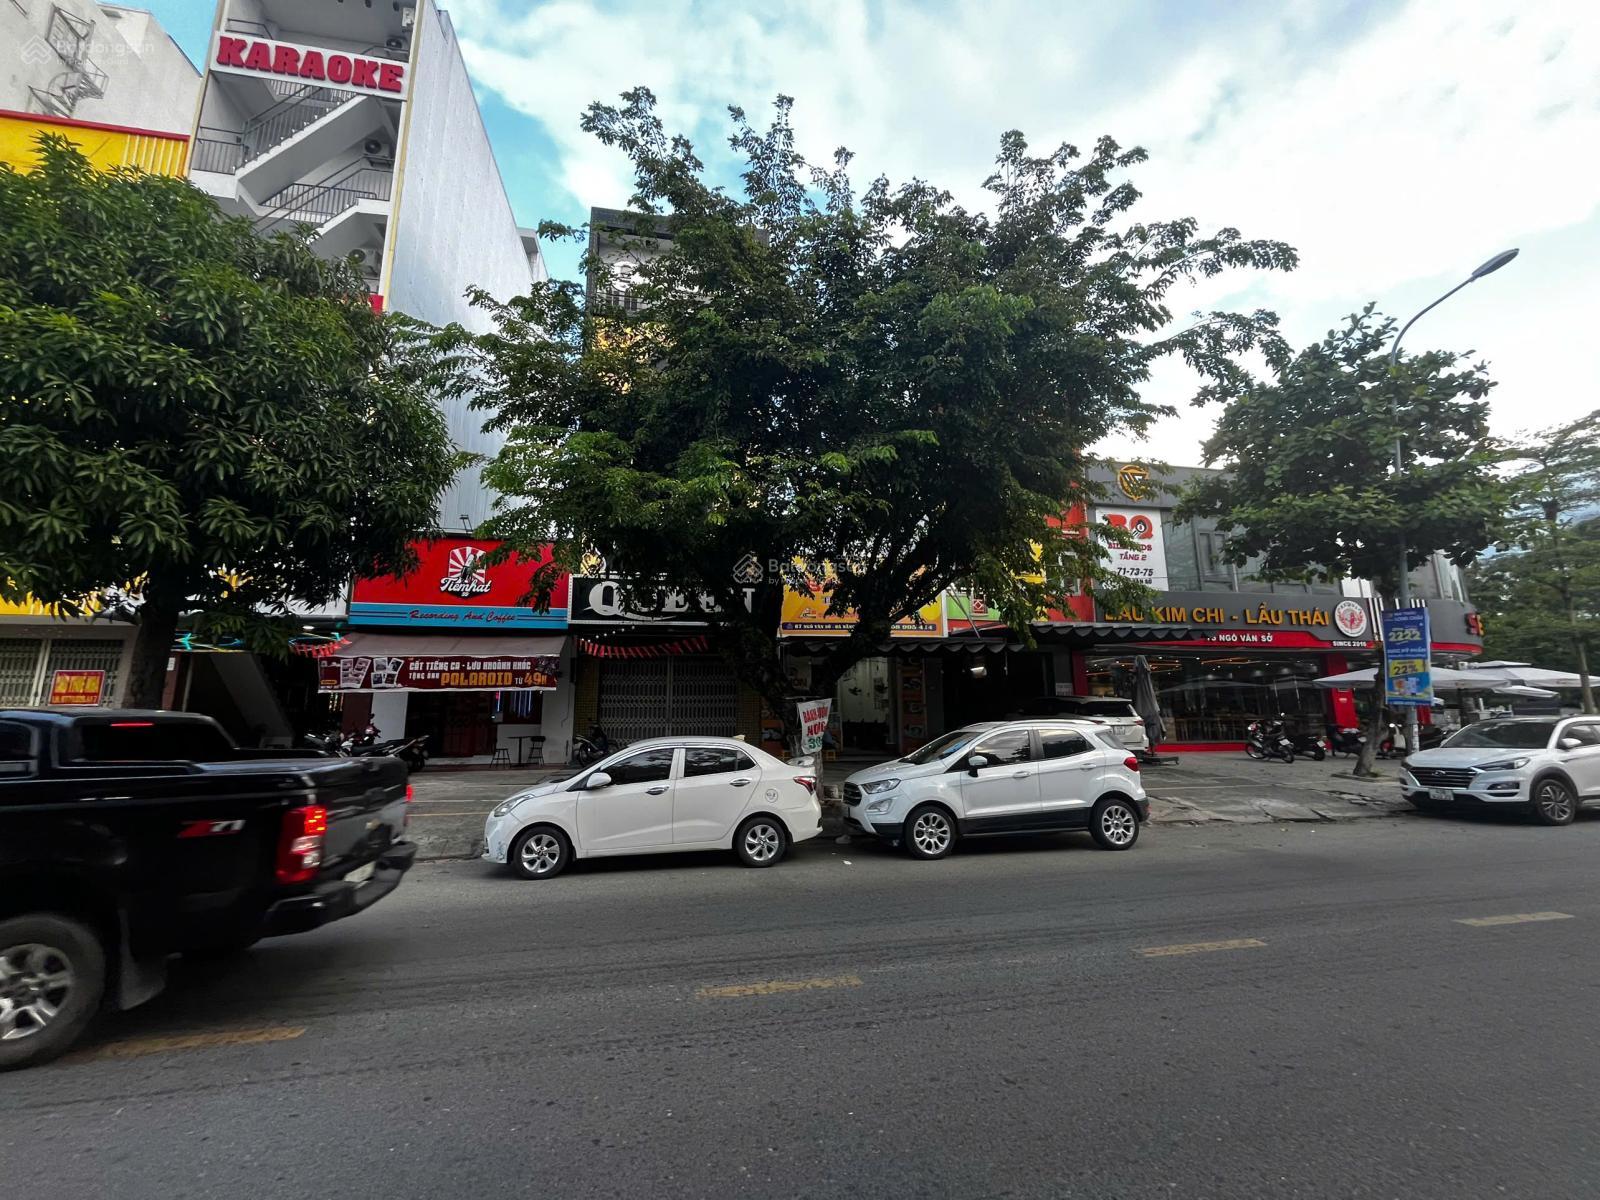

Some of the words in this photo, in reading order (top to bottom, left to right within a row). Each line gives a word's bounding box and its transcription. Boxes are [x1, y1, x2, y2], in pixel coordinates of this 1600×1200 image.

[216, 35, 404, 92] KARAOKE
[1117, 567, 1154, 576] 71-73-75
[409, 609, 459, 621] Recording
[463, 610, 485, 620] And
[486, 611, 516, 623] Coffee
[1152, 606, 1187, 622] KIM
[1192, 607, 1225, 623] CHI
[1245, 601, 1284, 625] LẨU
[1288, 607, 1330, 626] THÁI
[1219, 633, 1238, 642] NGÔ
[1240, 633, 1258, 642] VĂN
[1261, 632, 1273, 642] SỞ
[1388, 629, 1422, 641] 2222
[426, 660, 449, 671] TIẾNG
[450, 662, 461, 670] CA
[467, 661, 481, 670] LƯU
[440, 672, 513, 686] POLAROID
